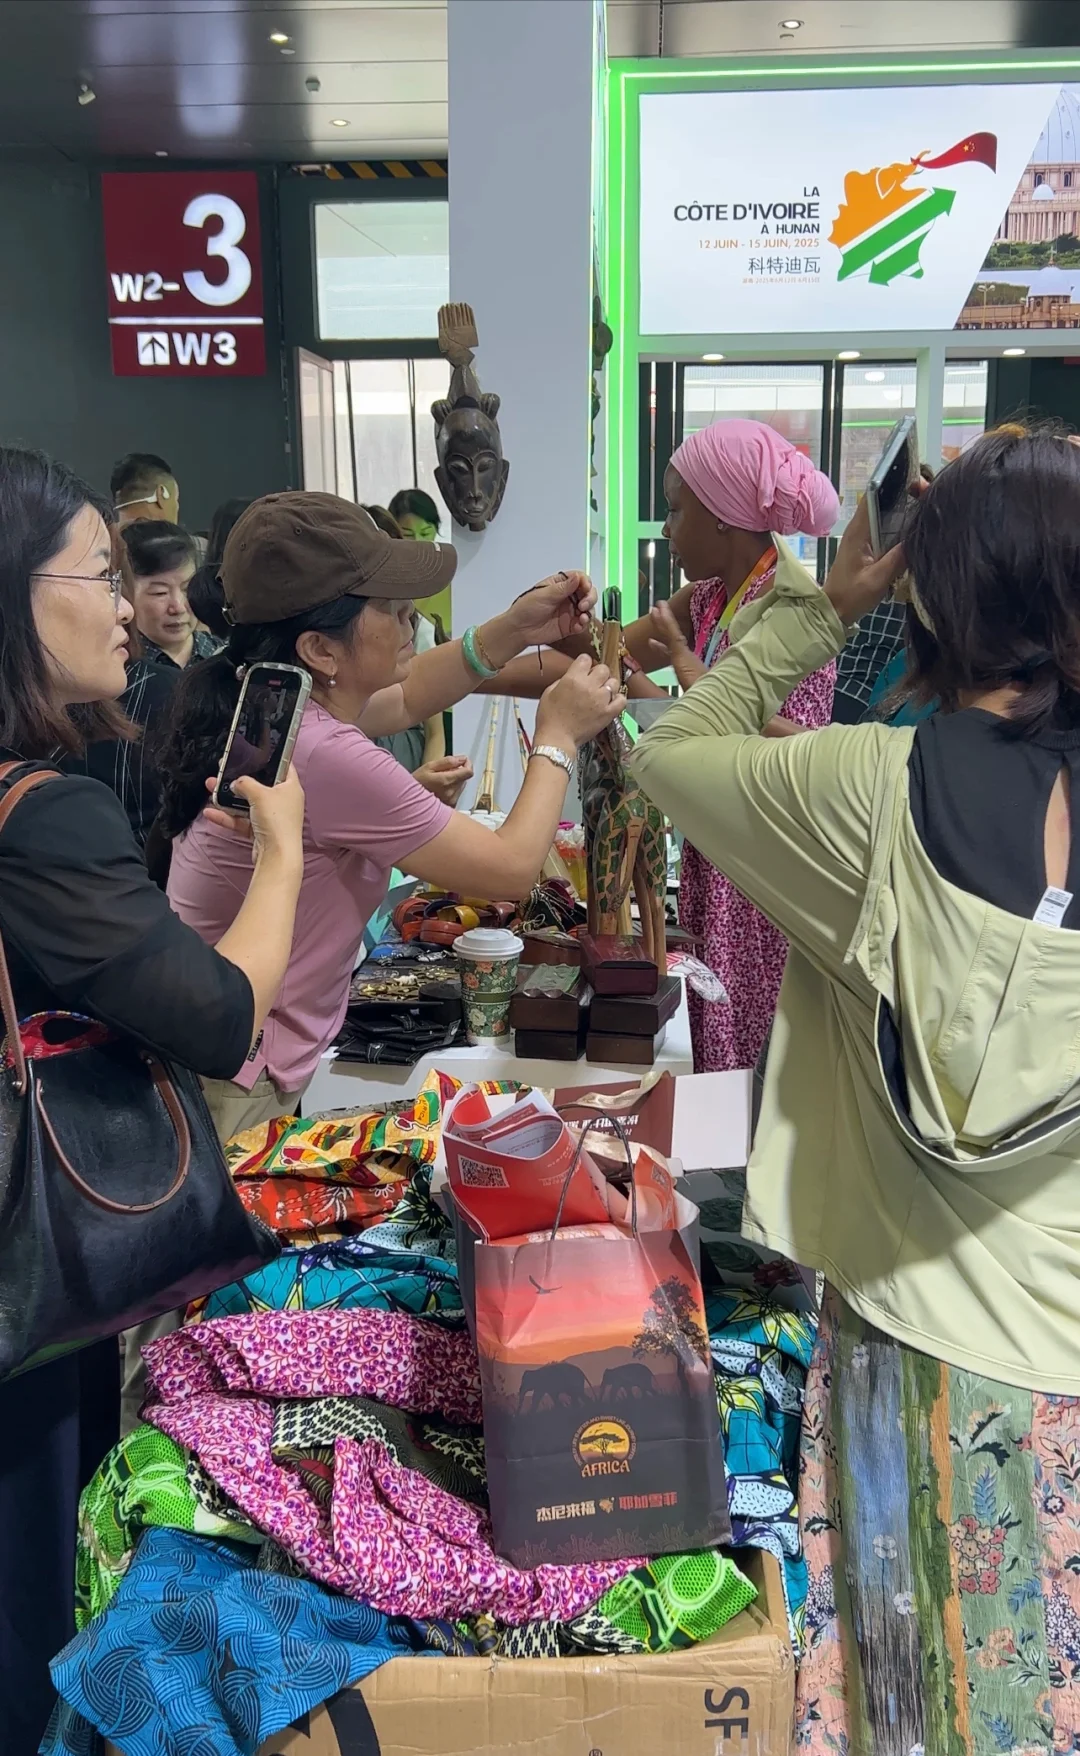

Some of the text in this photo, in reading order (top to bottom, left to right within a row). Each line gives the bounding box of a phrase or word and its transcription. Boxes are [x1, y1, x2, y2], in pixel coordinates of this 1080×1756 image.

[803, 187, 820, 197] LA
[674, 200, 820, 221] CÔTE D'IVOIRE
[760, 222, 820, 235] À HUNAN
[699, 240, 711, 249] 12
[713, 240, 738, 249] JUIN
[749, 239, 761, 249] 15
[763, 239, 792, 250] JUIN,
[794, 238, 820, 248] 2025
[748, 256, 820, 275] 科特迪瓦
[172, 331, 238, 366] W3
[581, 1459, 630, 1478] AFRICA
[536, 1491, 678, 1522] 杰尼来福 耶加雪菲
[704, 1686, 750, 1740] SF
